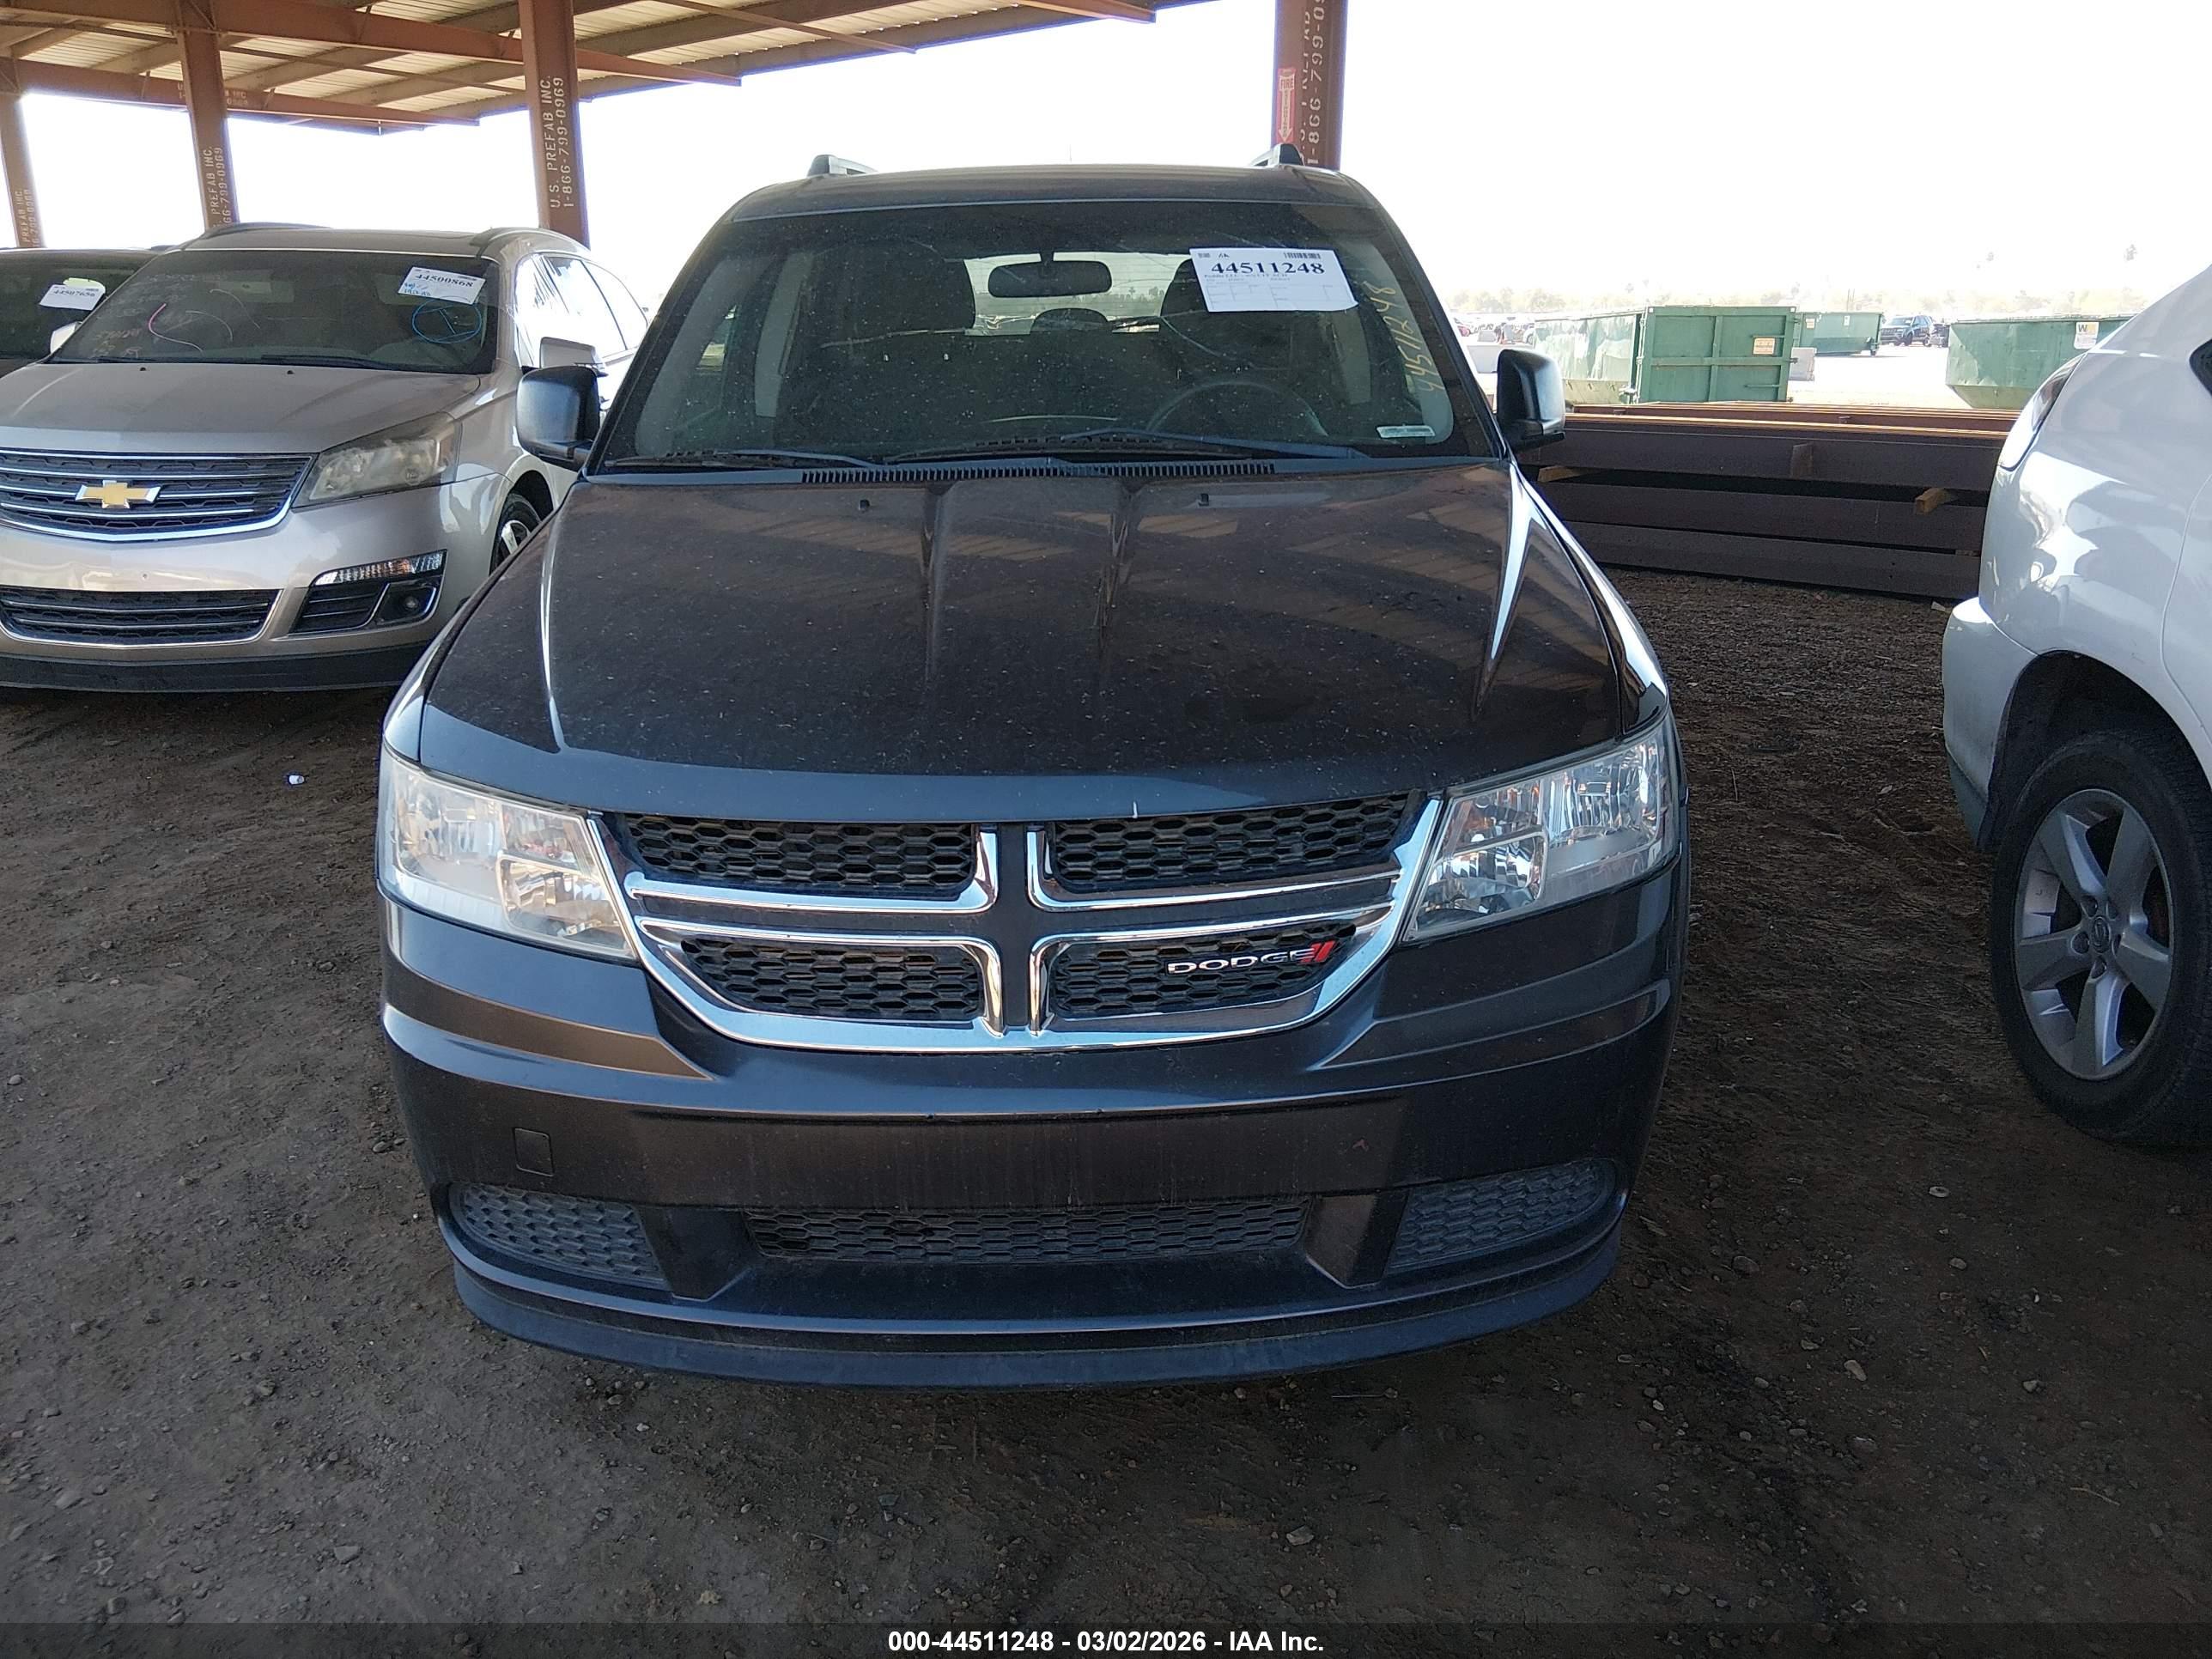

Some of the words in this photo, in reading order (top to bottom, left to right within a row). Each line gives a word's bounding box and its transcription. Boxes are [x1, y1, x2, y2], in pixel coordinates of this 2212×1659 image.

[540, 76, 553, 104] INC.
[1280, 78, 1293, 88] FIRE
[543, 112, 557, 171] PREFAB
[553, 77, 574, 208] 1-866-799-0969
[206, 173, 221, 216] PREFAB
[550, 180, 561, 208] U.S.
[415, 274, 474, 288] 44500868
[1212, 261, 1326, 275] 44511248
[1362, 280, 1446, 392] 44511248
[1167, 947, 1316, 975] DODGE
